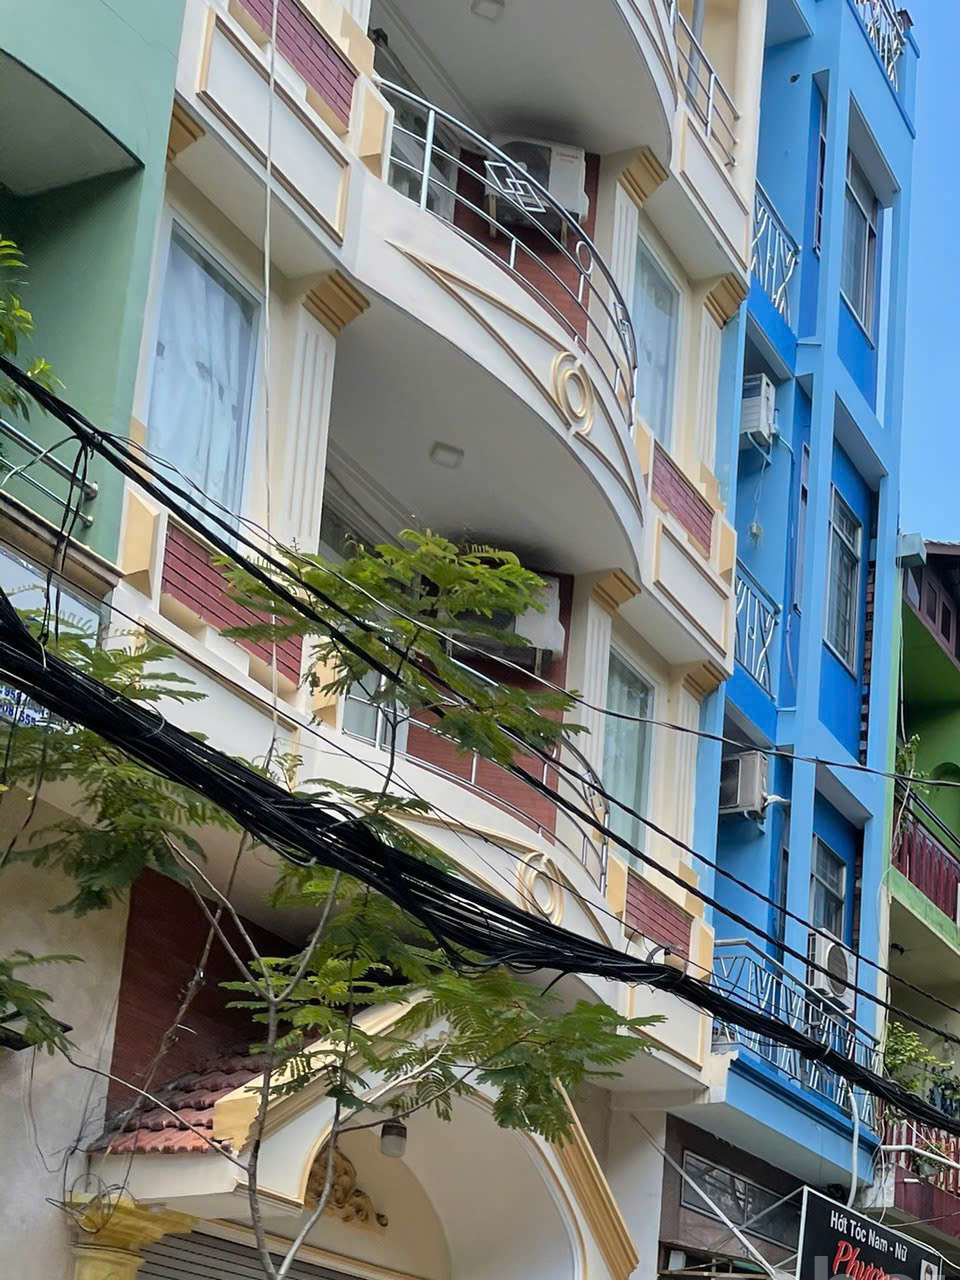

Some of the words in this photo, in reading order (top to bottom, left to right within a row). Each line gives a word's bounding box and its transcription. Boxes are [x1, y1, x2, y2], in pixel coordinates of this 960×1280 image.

[830, 1210, 848, 1234] Hớt
[850, 1220, 867, 1243] Tóc
[868, 1229, 888, 1254] Nam
